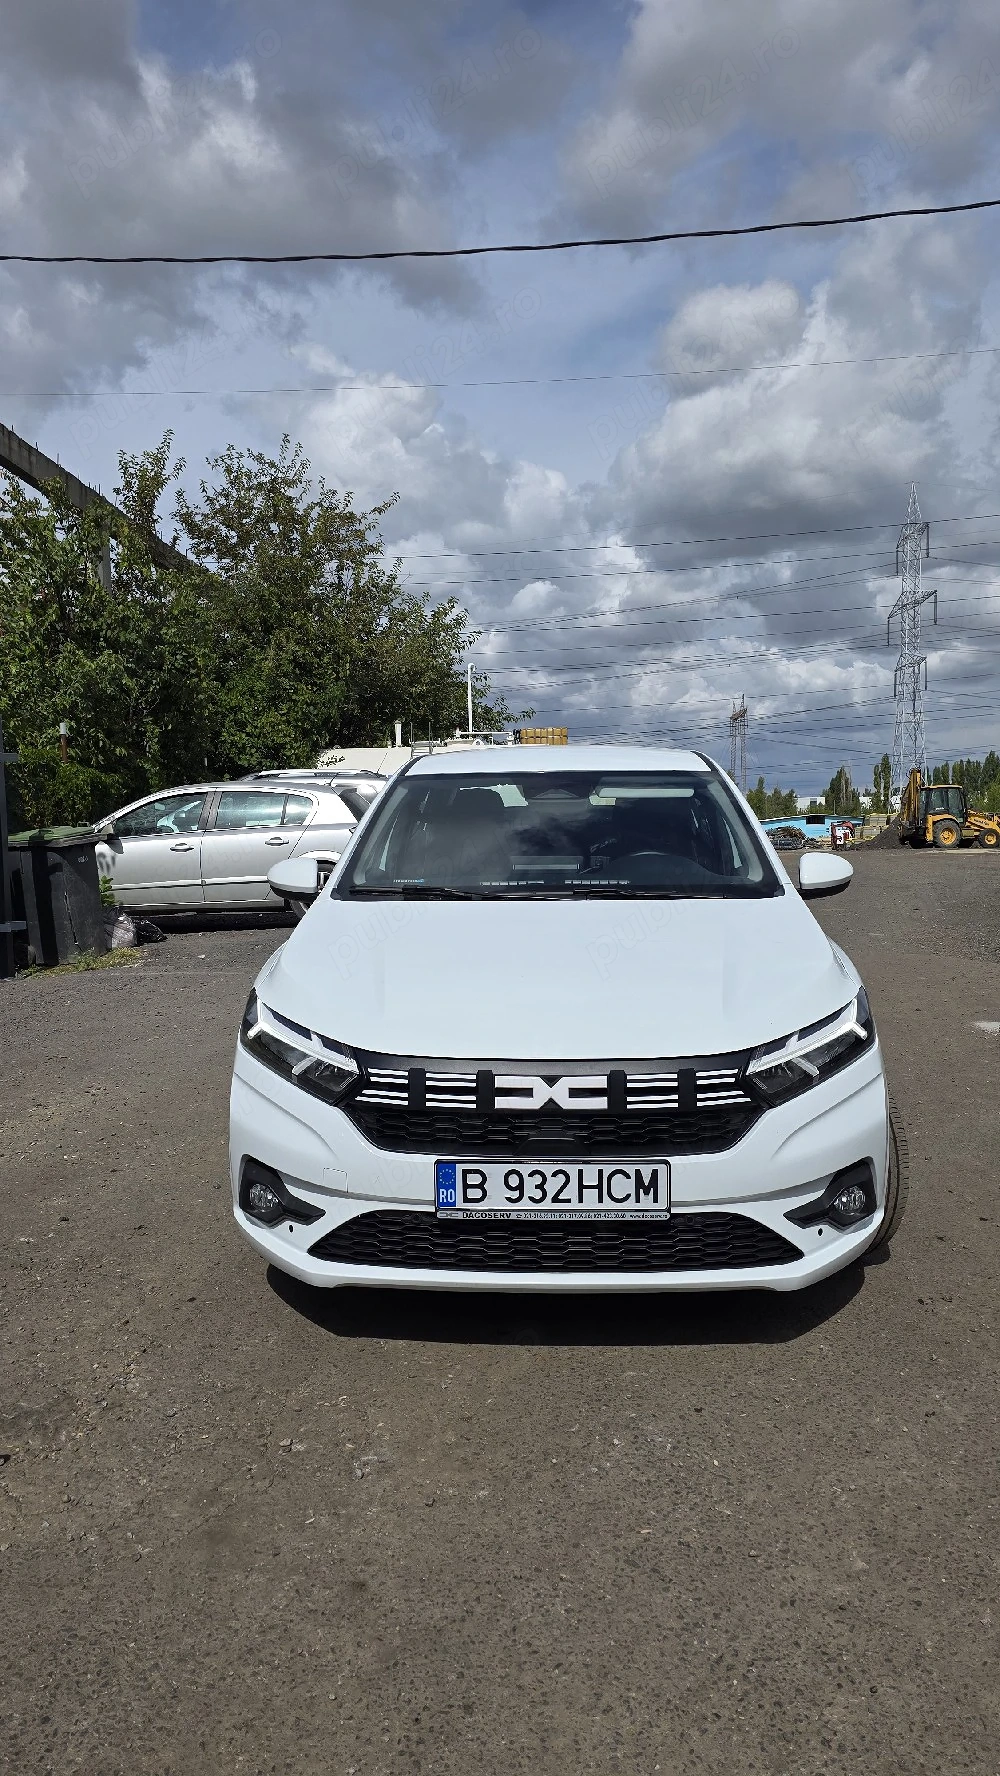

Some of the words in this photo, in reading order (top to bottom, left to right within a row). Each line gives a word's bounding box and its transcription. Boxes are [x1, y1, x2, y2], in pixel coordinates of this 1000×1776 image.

[440, 1189, 455, 1202] RO
[462, 1169, 487, 1203] B
[503, 1169, 658, 1203] 932HCM
